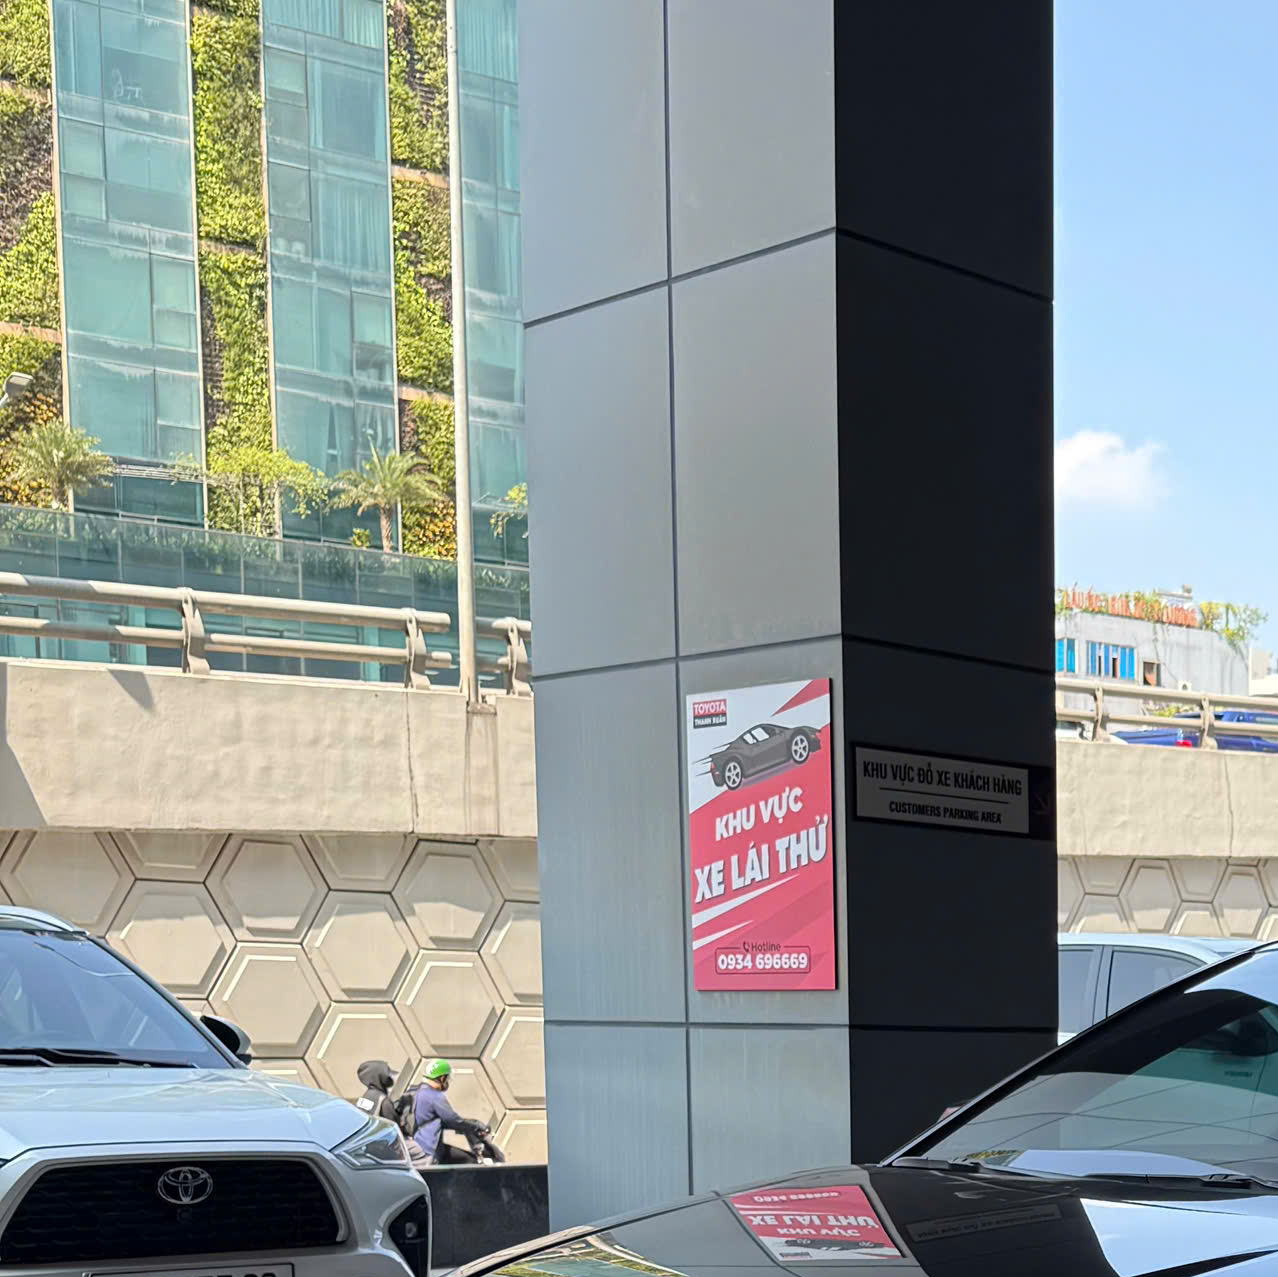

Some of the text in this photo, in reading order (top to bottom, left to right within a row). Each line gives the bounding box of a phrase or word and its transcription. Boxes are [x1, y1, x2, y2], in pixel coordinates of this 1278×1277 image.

[694, 700, 726, 714] TOYOTA
[863, 761, 887, 780] KHU
[891, 764, 914, 786] VỰC
[936, 769, 951, 787] XE
[954, 770, 990, 792] KHÁCH
[993, 775, 1022, 796] HÀNG
[715, 786, 803, 841] KHU VỰC
[889, 801, 1002, 825] CUSTOMERS PARKING AREA
[694, 814, 829, 904] XE LÁI THỬ
[751, 941, 781, 952] Hotline
[717, 952, 808, 970] 0934 696669
